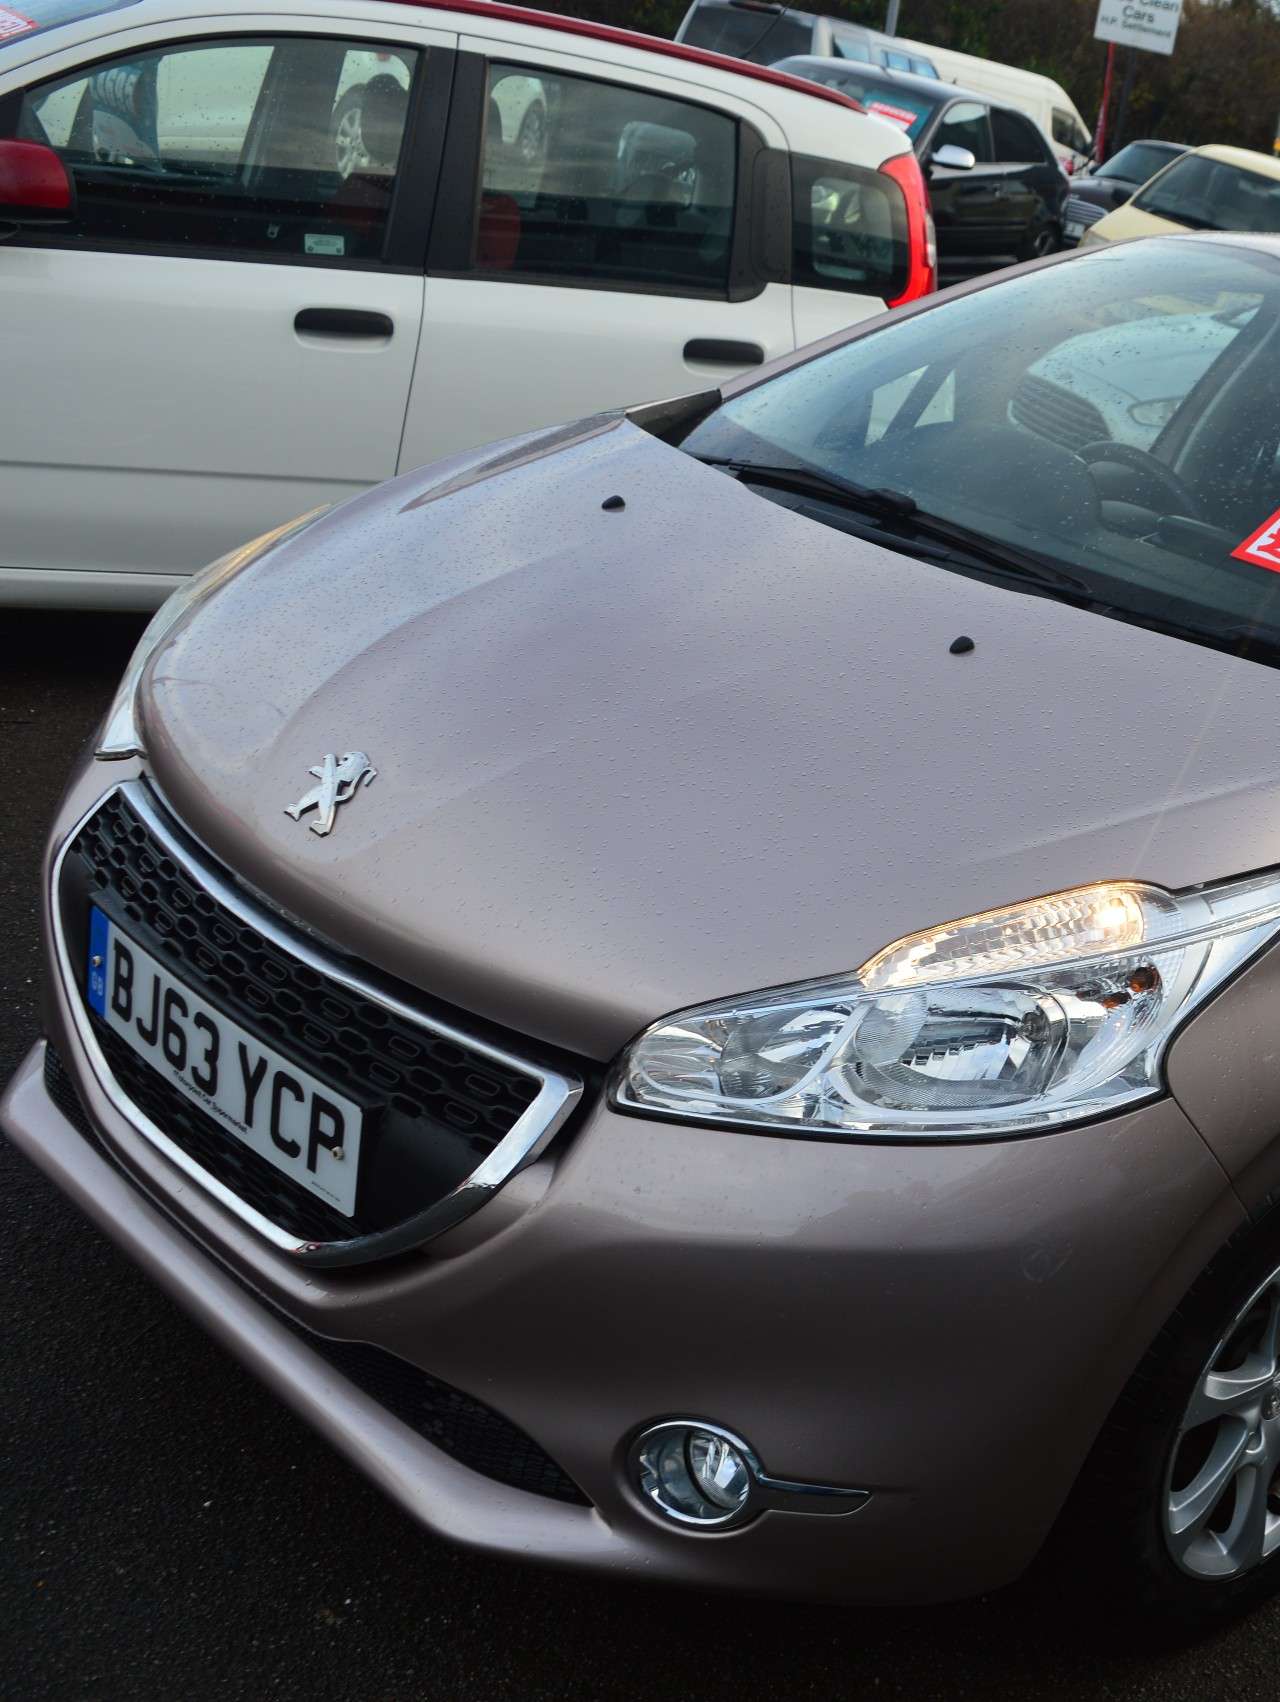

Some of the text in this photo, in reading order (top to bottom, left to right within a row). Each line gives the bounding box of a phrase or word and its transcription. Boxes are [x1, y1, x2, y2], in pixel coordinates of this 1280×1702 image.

[1122, 5, 1155, 23] Cars
[111, 938, 346, 1175] BJ63 YCP
